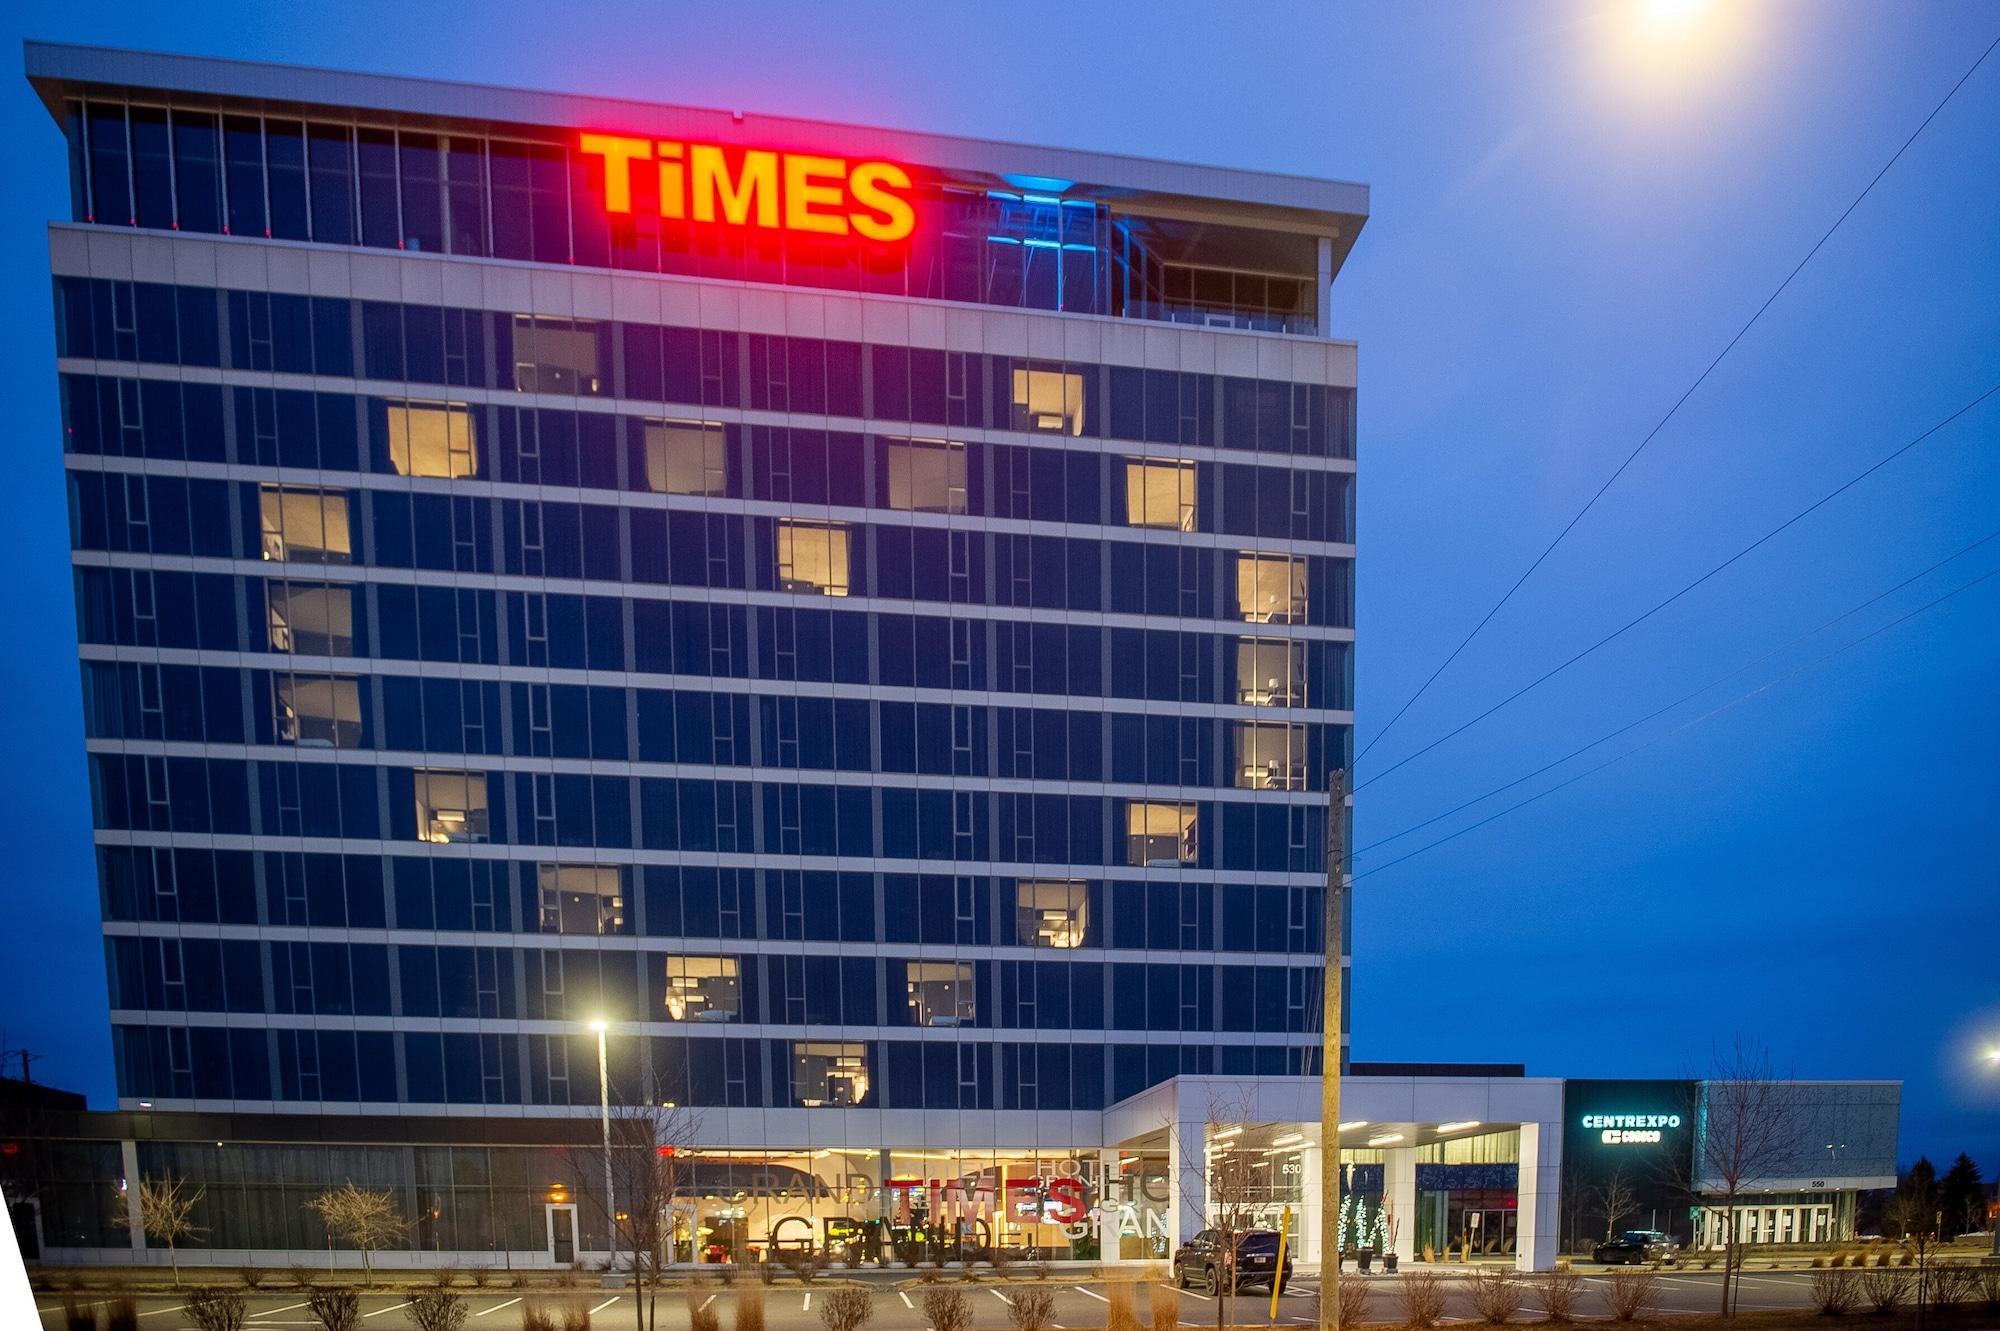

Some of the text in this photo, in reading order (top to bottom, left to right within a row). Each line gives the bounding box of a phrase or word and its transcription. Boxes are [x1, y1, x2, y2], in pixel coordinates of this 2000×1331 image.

[1582, 1115, 1681, 1128] CENTREXPO
[1282, 1163, 1302, 1175] 530
[717, 1172, 875, 1205] GRAND
[1811, 1180, 1825, 1188] 550
[885, 1179, 1087, 1224] TIMES
